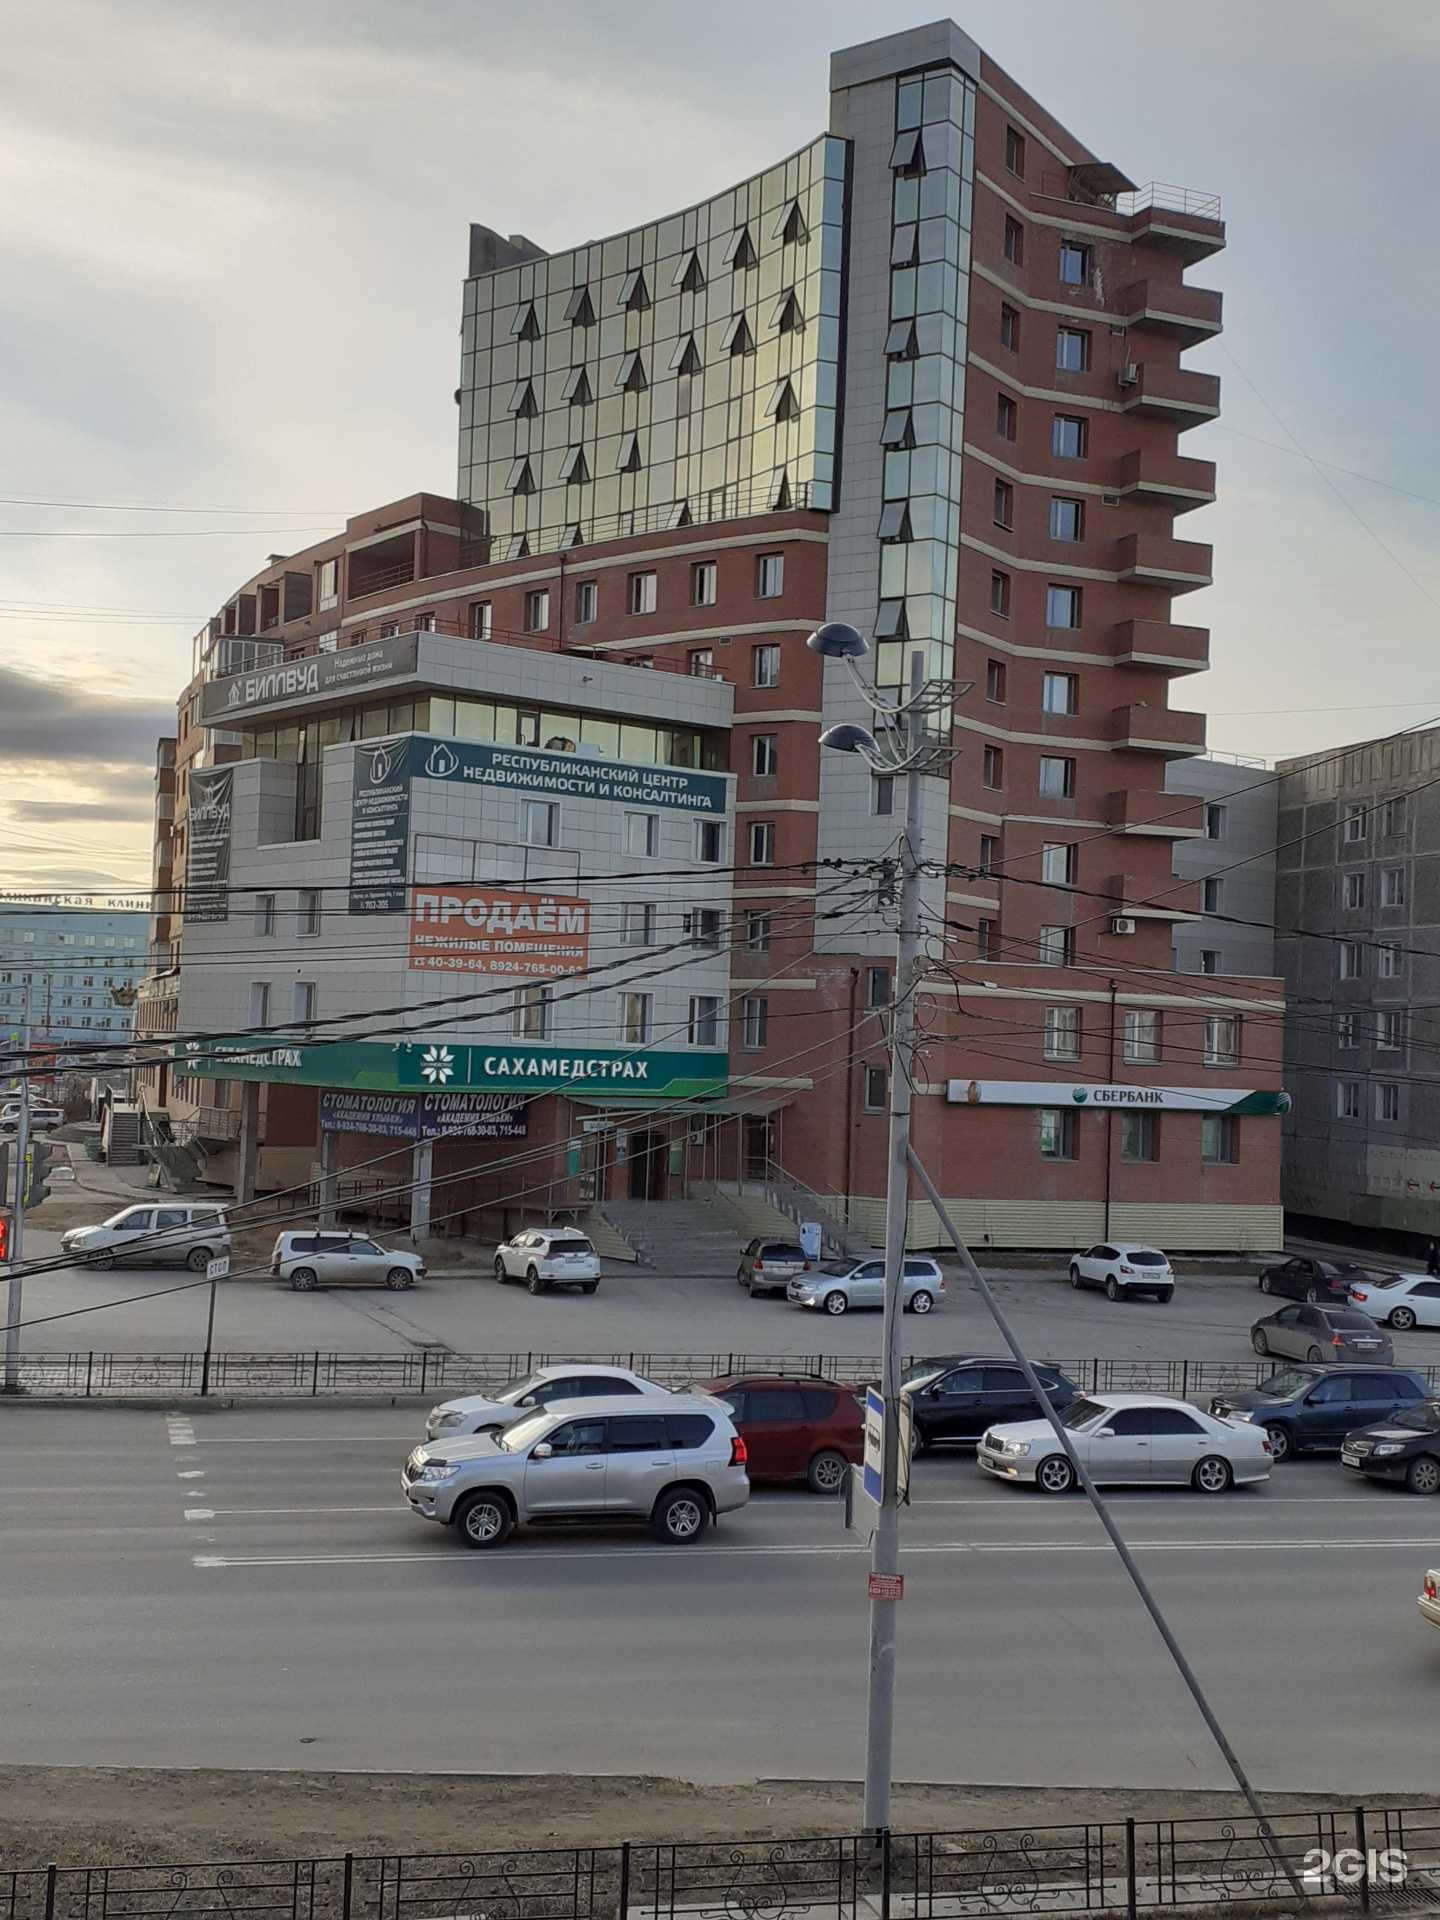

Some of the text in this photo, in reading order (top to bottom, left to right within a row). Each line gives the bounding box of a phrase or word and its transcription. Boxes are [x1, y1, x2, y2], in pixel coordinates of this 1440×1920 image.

[246, 663, 319, 703] БИЛЛВУД
[491, 753, 688, 790] РЕСПУБЛИКАНСКИЙ ЦЕНТР
[463, 765, 712, 809] НЕДВИЖИМОСТИ И КОНСАЛТИНГА
[415, 894, 585, 935] ПРОДАЁМ
[415, 934, 584, 958] НЕЖИЛЫЕ ПОМЕЩЕНИЯ
[484, 1056, 648, 1079] САХАМЕДСТРАХ
[323, 1093, 416, 1115] СТОМАТОЛОГИЯ
[424, 1093, 526, 1112] СТОМАТОЛОГИЯ
[1093, 1089, 1164, 1103] СБЕРБАНК
